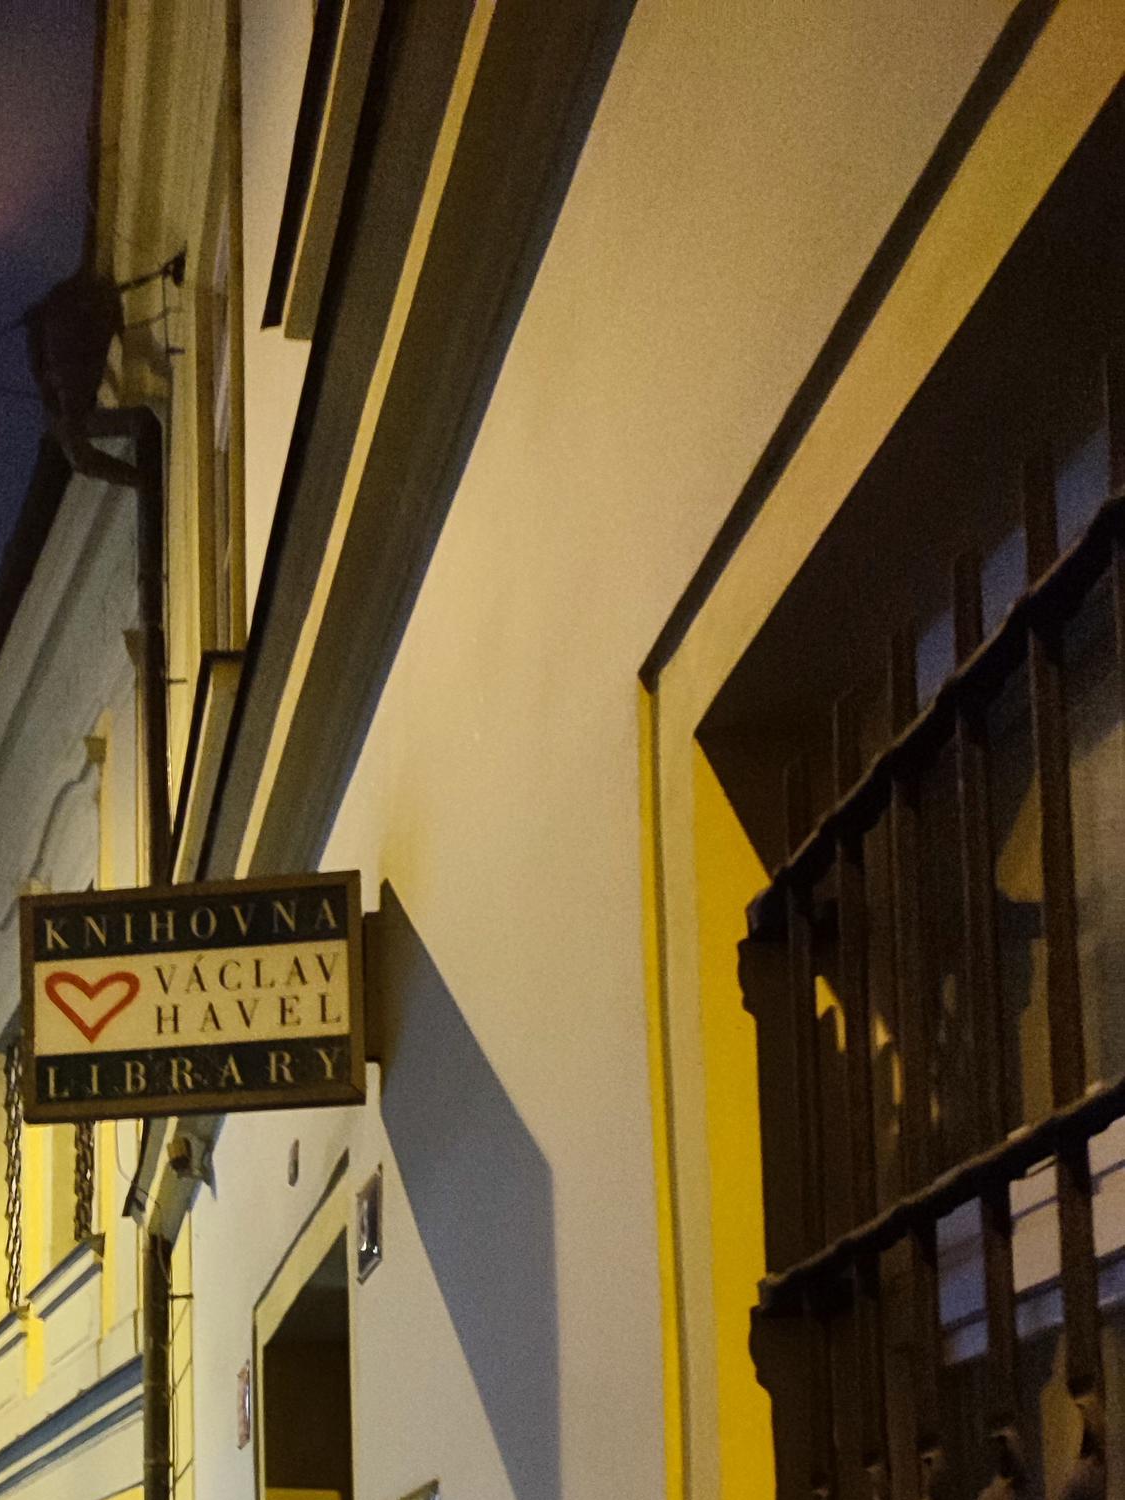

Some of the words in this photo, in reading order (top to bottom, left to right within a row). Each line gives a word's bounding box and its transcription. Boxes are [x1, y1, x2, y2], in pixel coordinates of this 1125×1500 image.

[44, 899, 337, 950] KNIHOVNA
[154, 953, 340, 995] VÁCLAV
[155, 993, 342, 1035] HAVEL
[48, 1049, 342, 1099] LIBRARY
